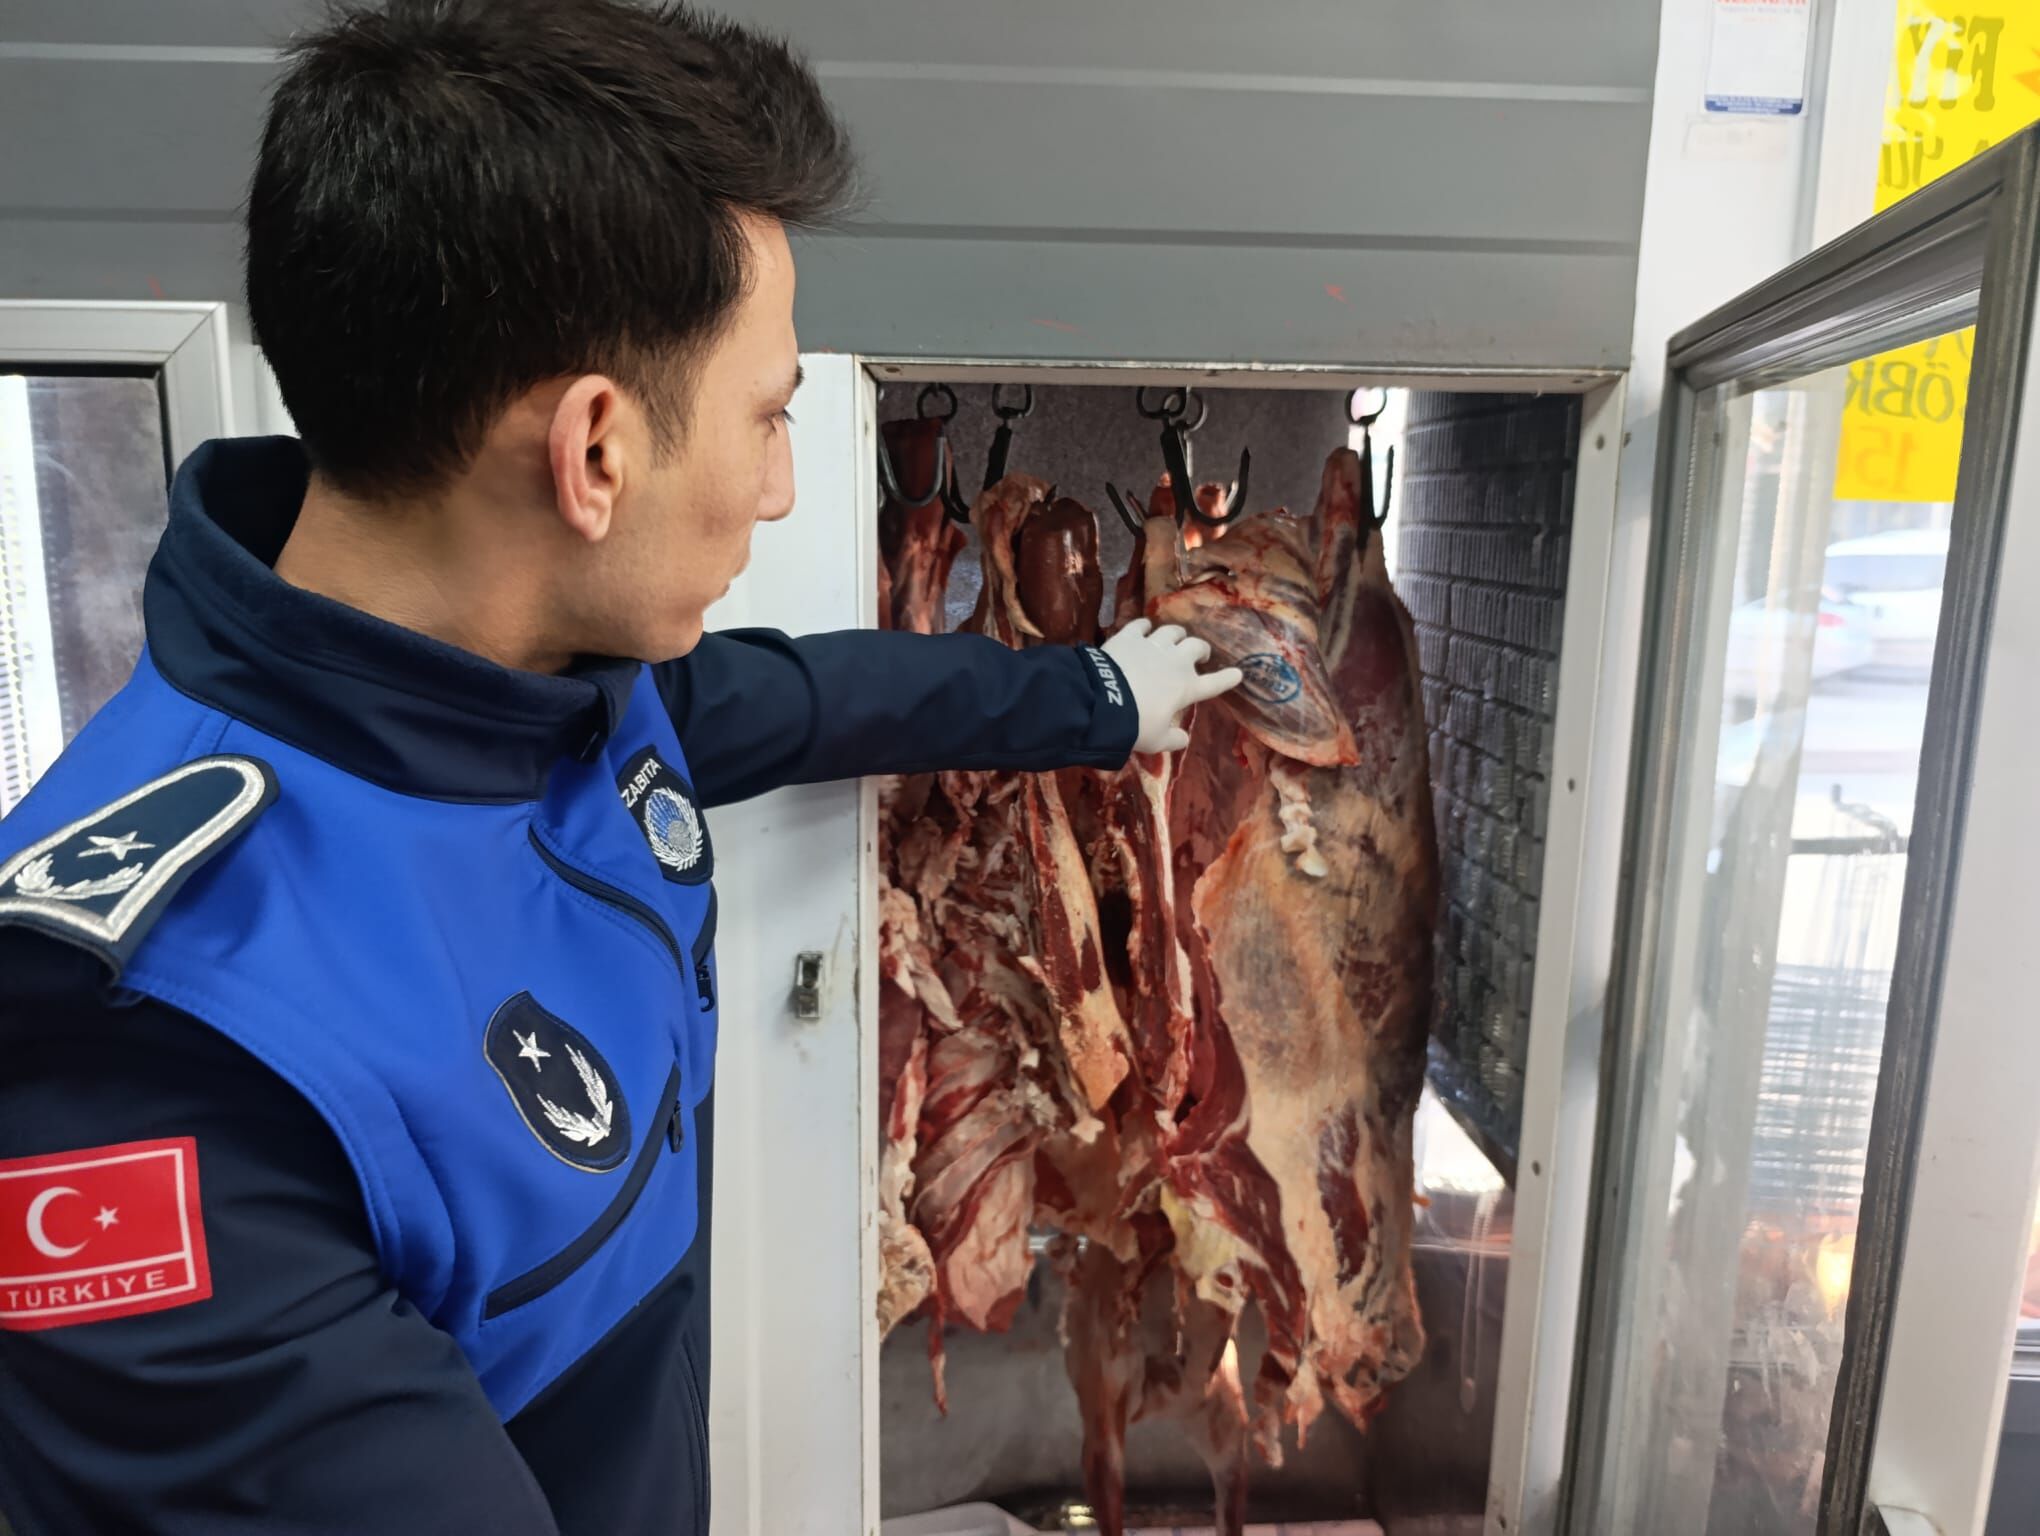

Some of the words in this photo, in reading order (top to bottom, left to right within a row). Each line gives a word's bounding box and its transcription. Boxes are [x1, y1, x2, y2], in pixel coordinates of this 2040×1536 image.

[1084, 646, 1124, 707] ZABITA
[620, 757, 663, 809] ZABITA
[7, 1268, 167, 1310] TÜRKİYE
